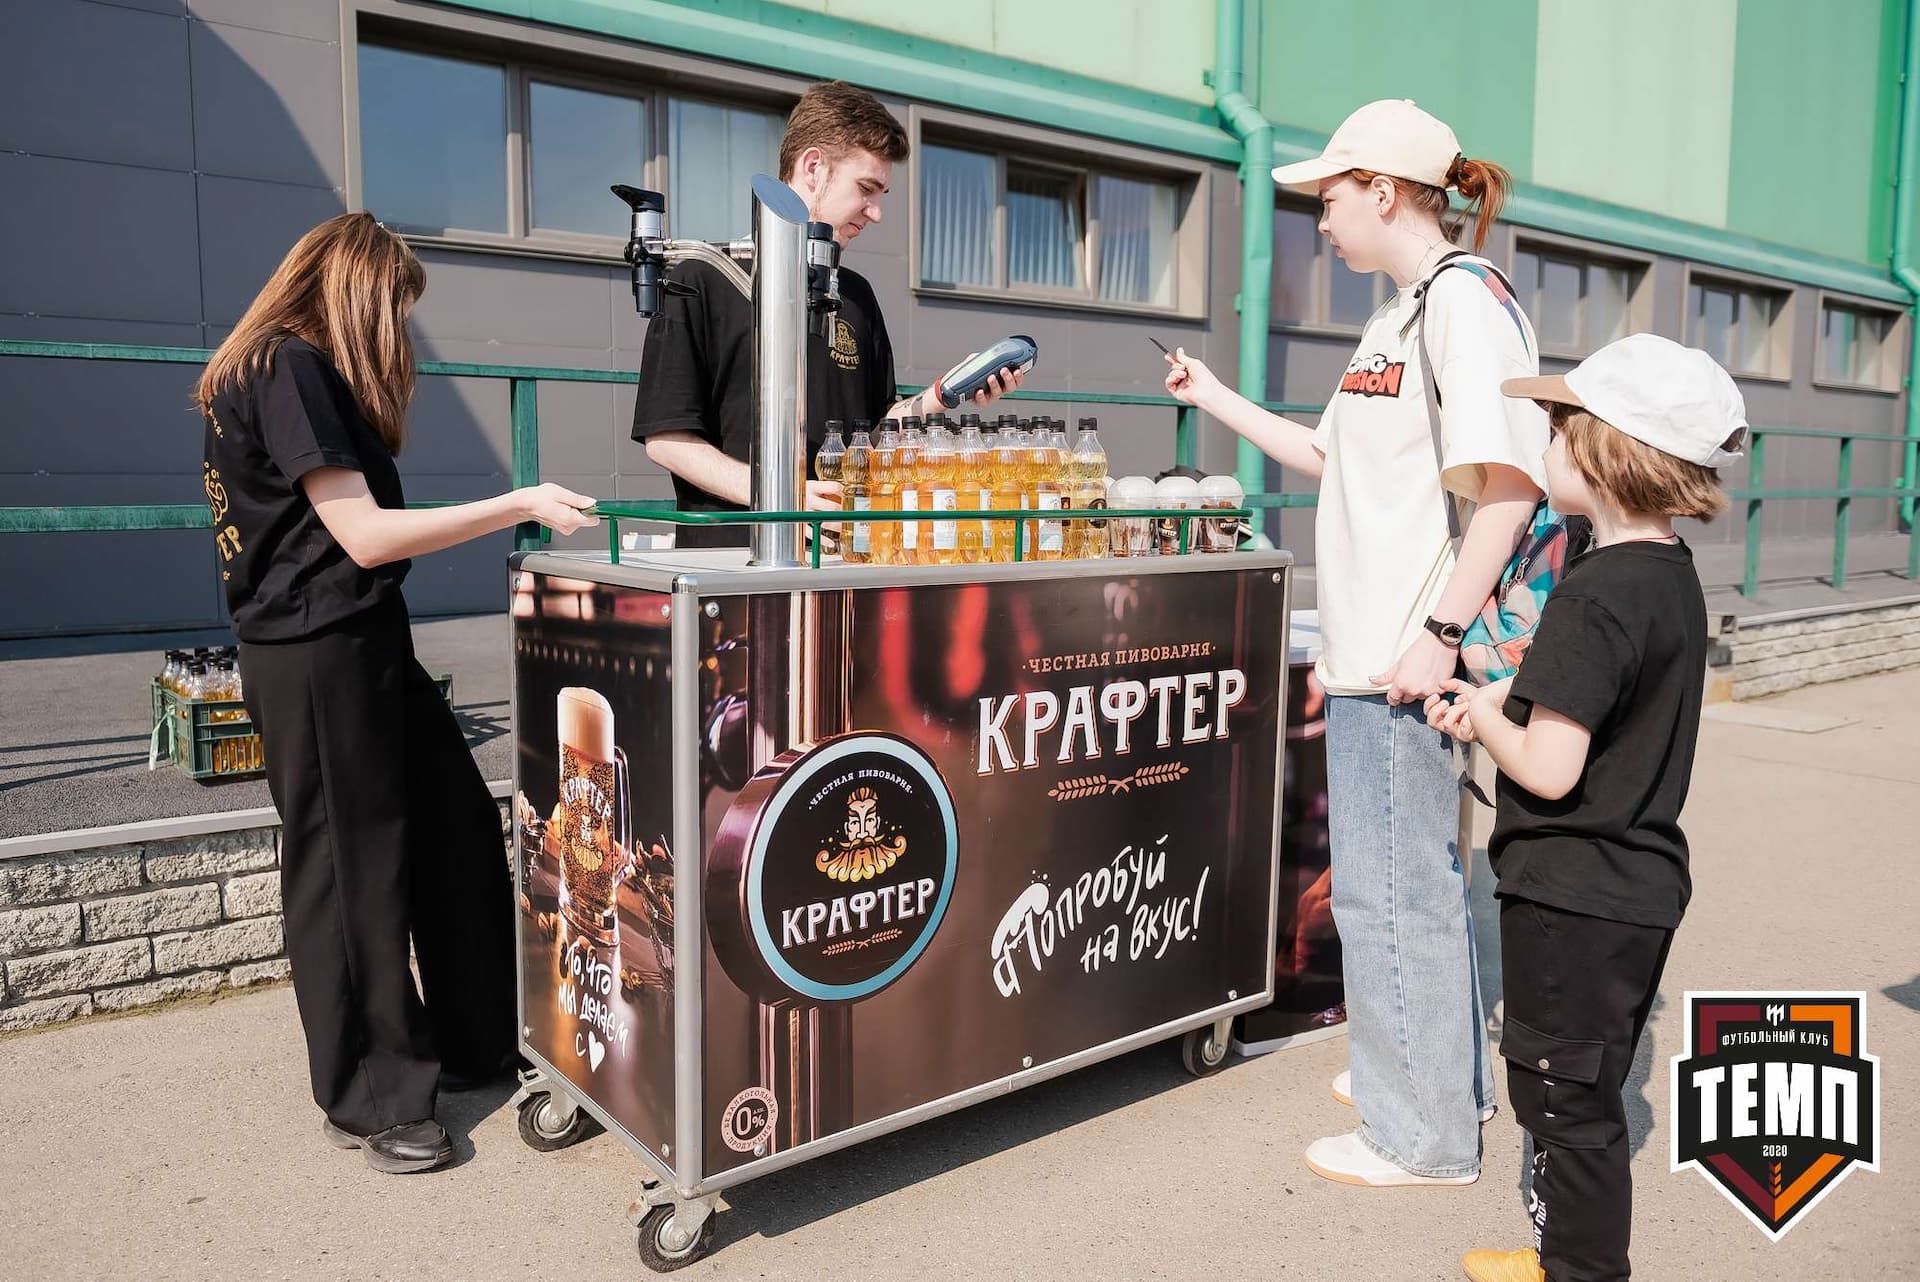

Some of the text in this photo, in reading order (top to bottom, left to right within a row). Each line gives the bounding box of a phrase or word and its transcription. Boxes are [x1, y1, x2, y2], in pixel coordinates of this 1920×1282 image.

[829, 349, 860, 365] КРАФТЕ
[1029, 642, 1211, 673] ЧЕСТНАЯ ПИВОВАРНЯ
[976, 669, 1247, 777] КРАФТЕР
[811, 769, 912, 806] ЧЕСТНАЯ ПИВОВАРНЯ
[781, 877, 937, 949] КРАФТЕР
[1080, 866, 1210, 973] на вкус!
